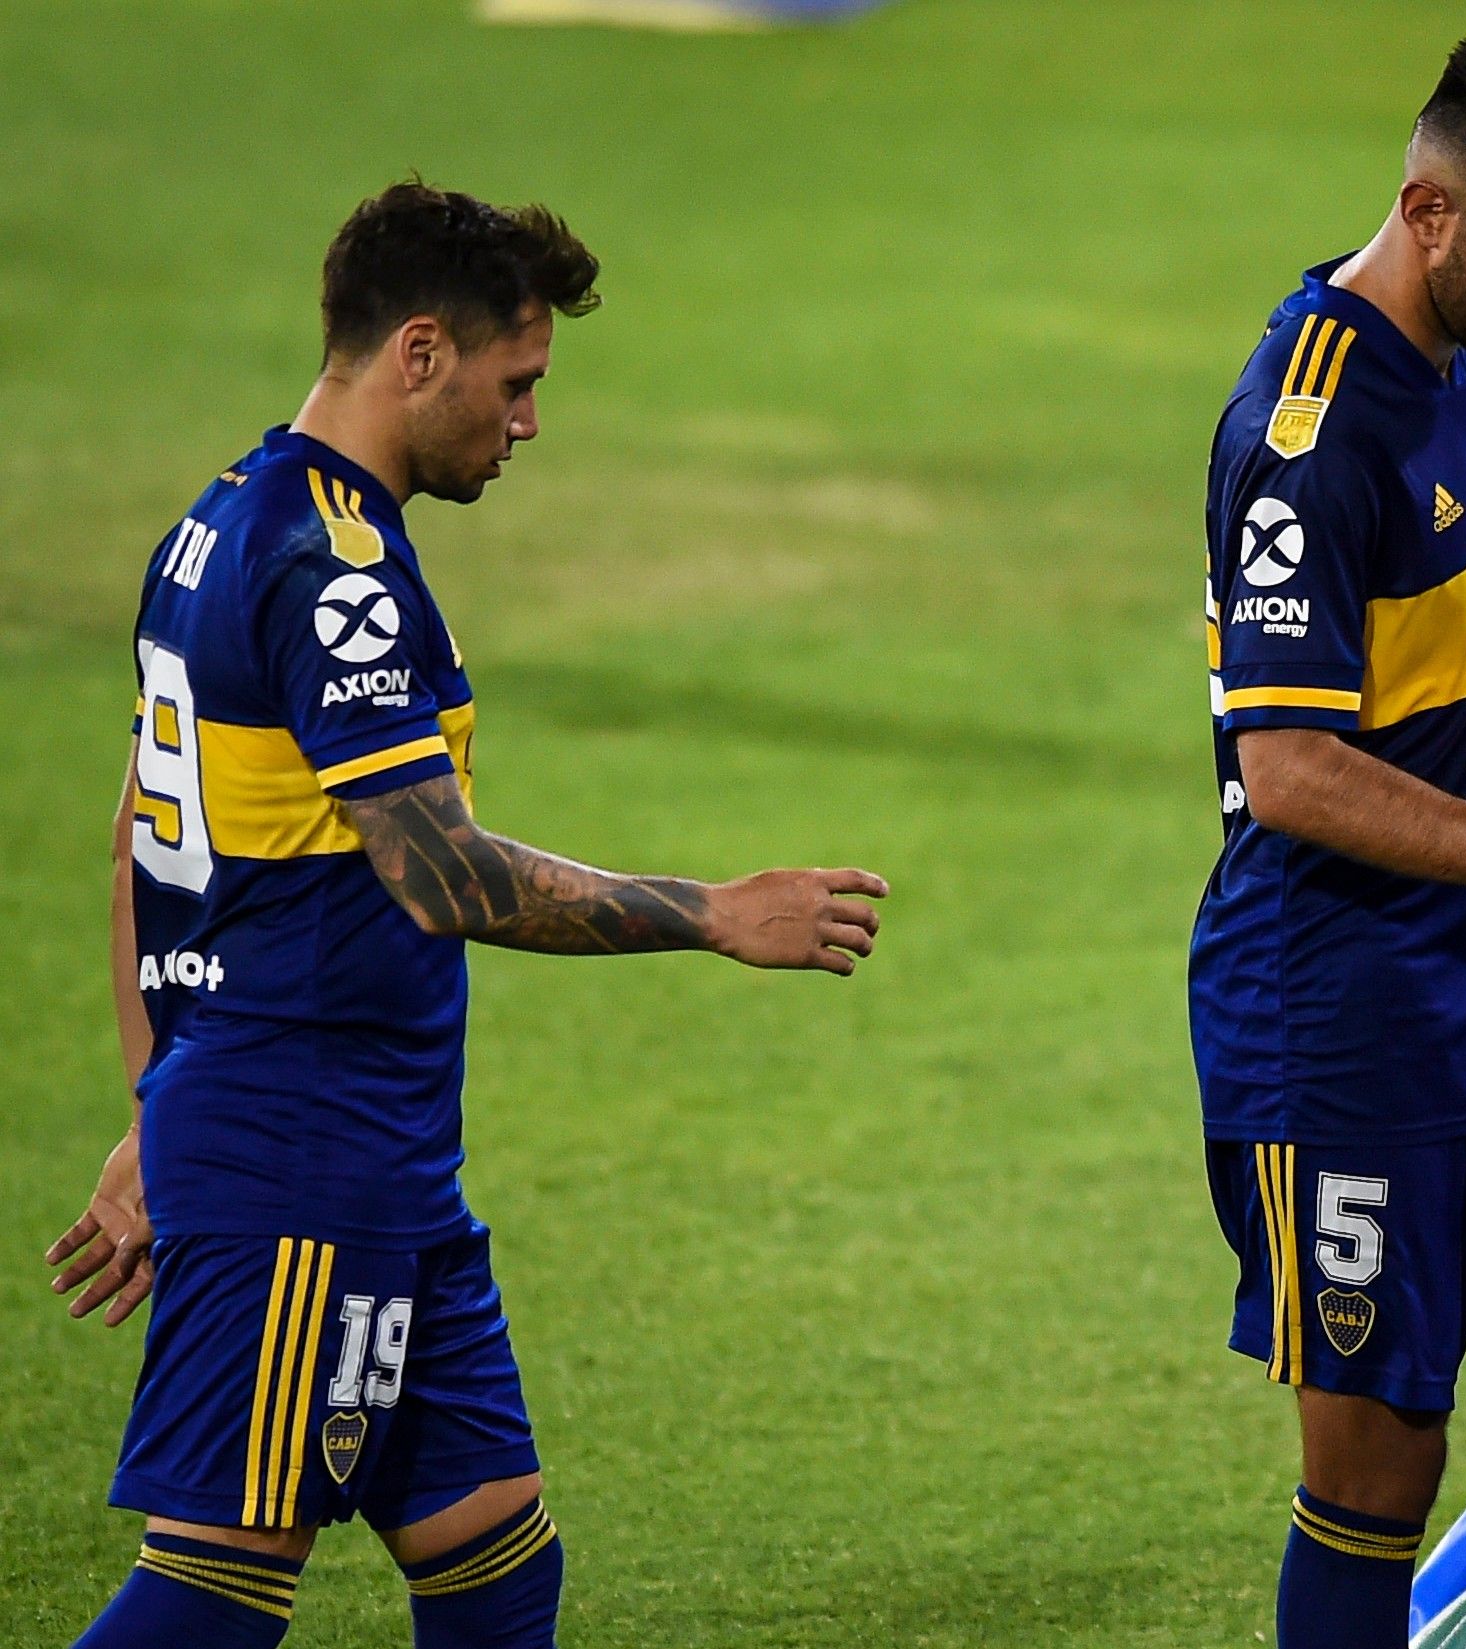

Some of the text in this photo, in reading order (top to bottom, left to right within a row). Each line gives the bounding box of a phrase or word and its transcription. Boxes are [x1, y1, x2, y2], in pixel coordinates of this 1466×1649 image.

[1231, 597, 1310, 625] AXION
[1262, 622, 1308, 638] energy
[321, 668, 411, 708] AXION
[1315, 1171, 1389, 1287] 5
[1325, 1309, 1367, 1328] CABJ
[328, 1294, 413, 1409] 19
[328, 1435, 358, 1450] CABJ
